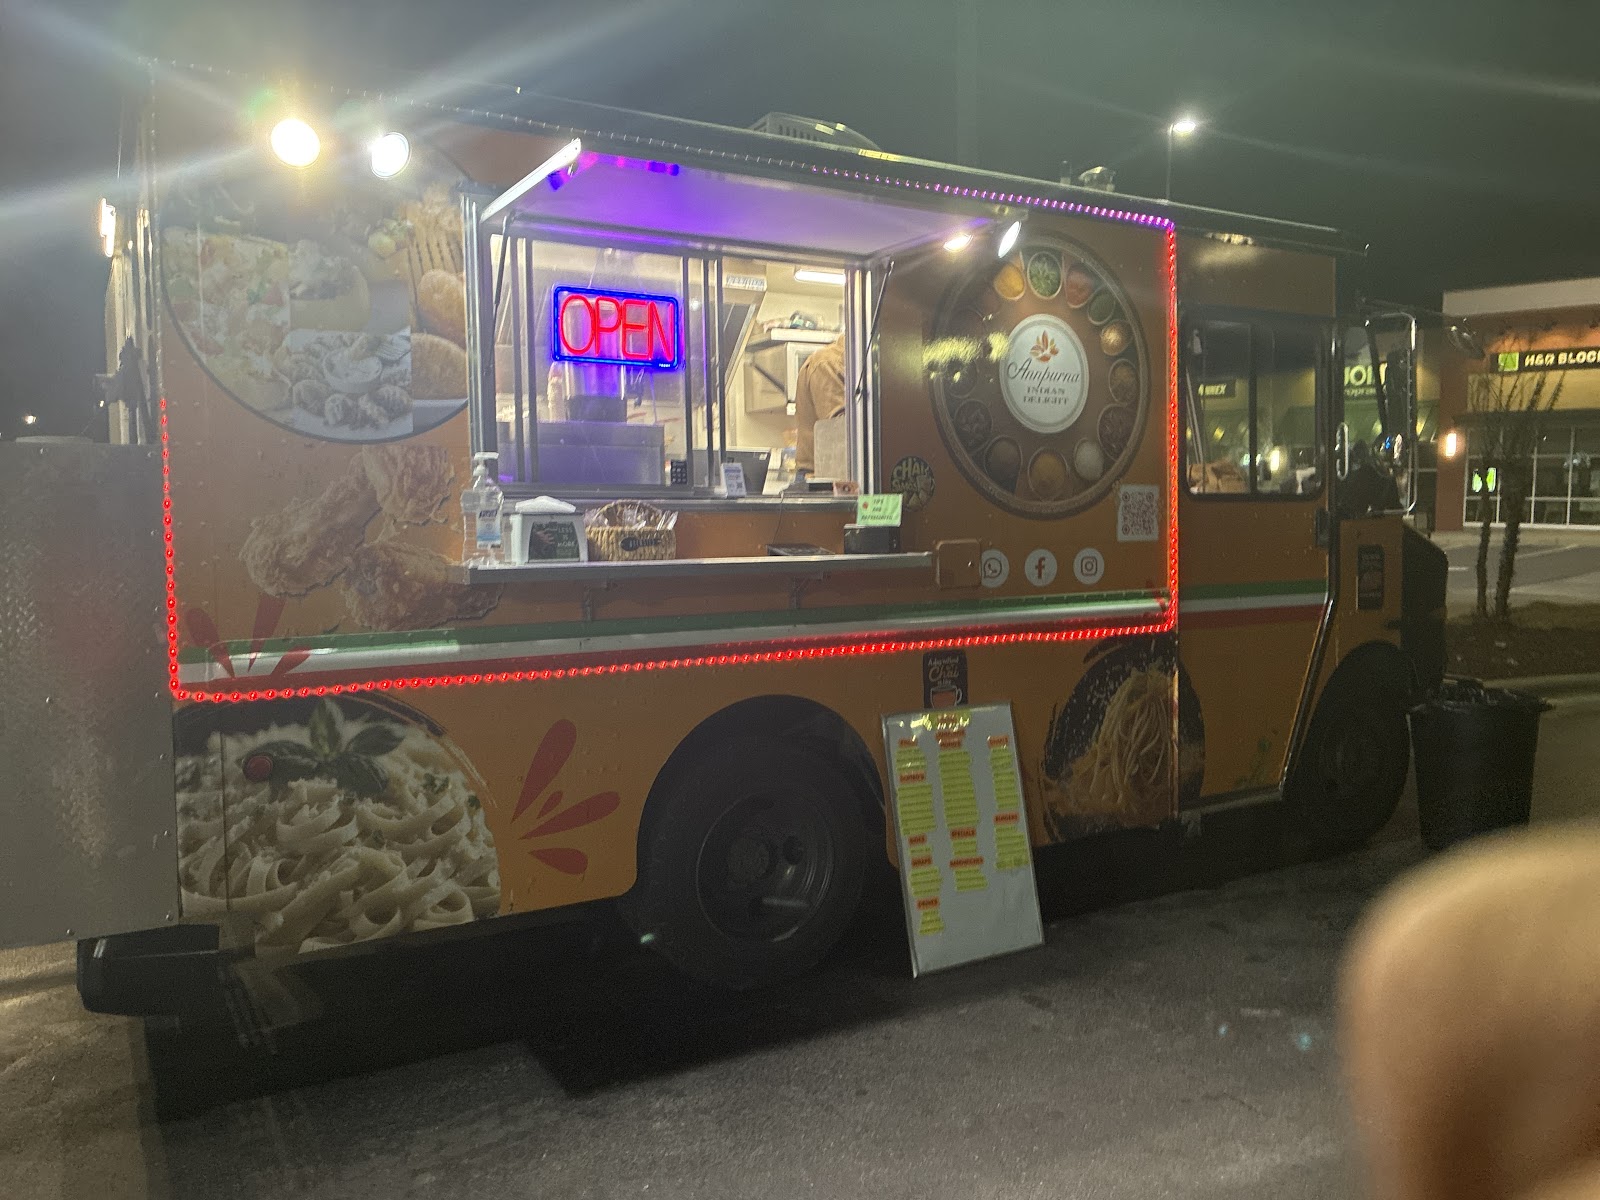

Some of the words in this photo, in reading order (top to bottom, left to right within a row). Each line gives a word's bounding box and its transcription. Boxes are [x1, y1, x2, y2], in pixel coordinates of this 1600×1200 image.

[560, 294, 674, 362] OPEN
[1026, 385, 1066, 396] INDIAN
[1022, 395, 1070, 406] DELIGHT
